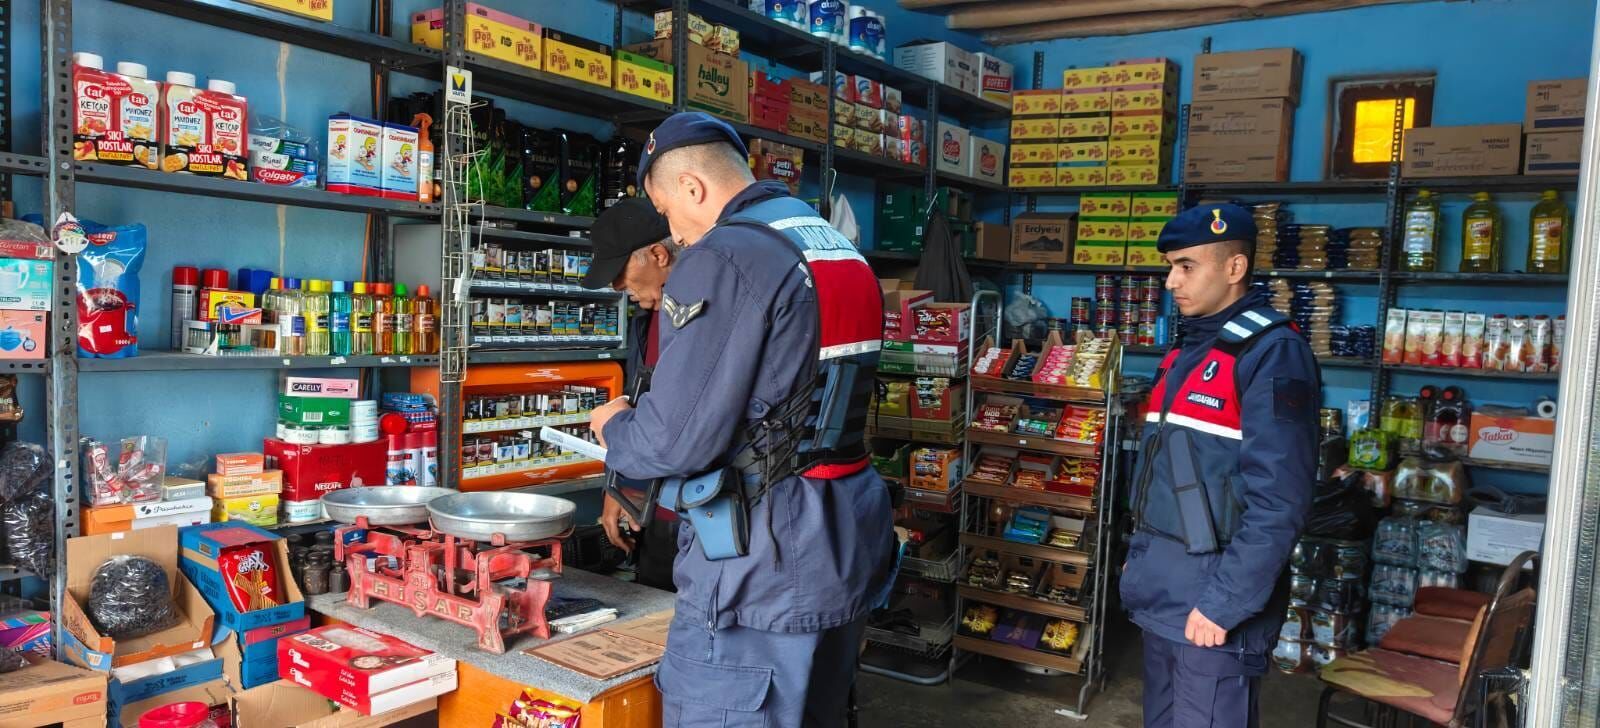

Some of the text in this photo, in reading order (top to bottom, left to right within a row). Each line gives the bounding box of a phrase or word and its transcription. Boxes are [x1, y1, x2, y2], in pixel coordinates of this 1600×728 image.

[86, 88, 103, 98] tat
[130, 95, 147, 104] tat
[80, 100, 109, 112] KETÇAP
[180, 104, 195, 114] tat
[220, 110, 237, 120] tat
[98, 141, 133, 152] DOSTLAR
[189, 154, 222, 164] DOSTLAR
[257, 169, 297, 182] Colgate
[292, 383, 322, 392] CARELLY
[1187, 392, 1219, 408] JANDARMA
